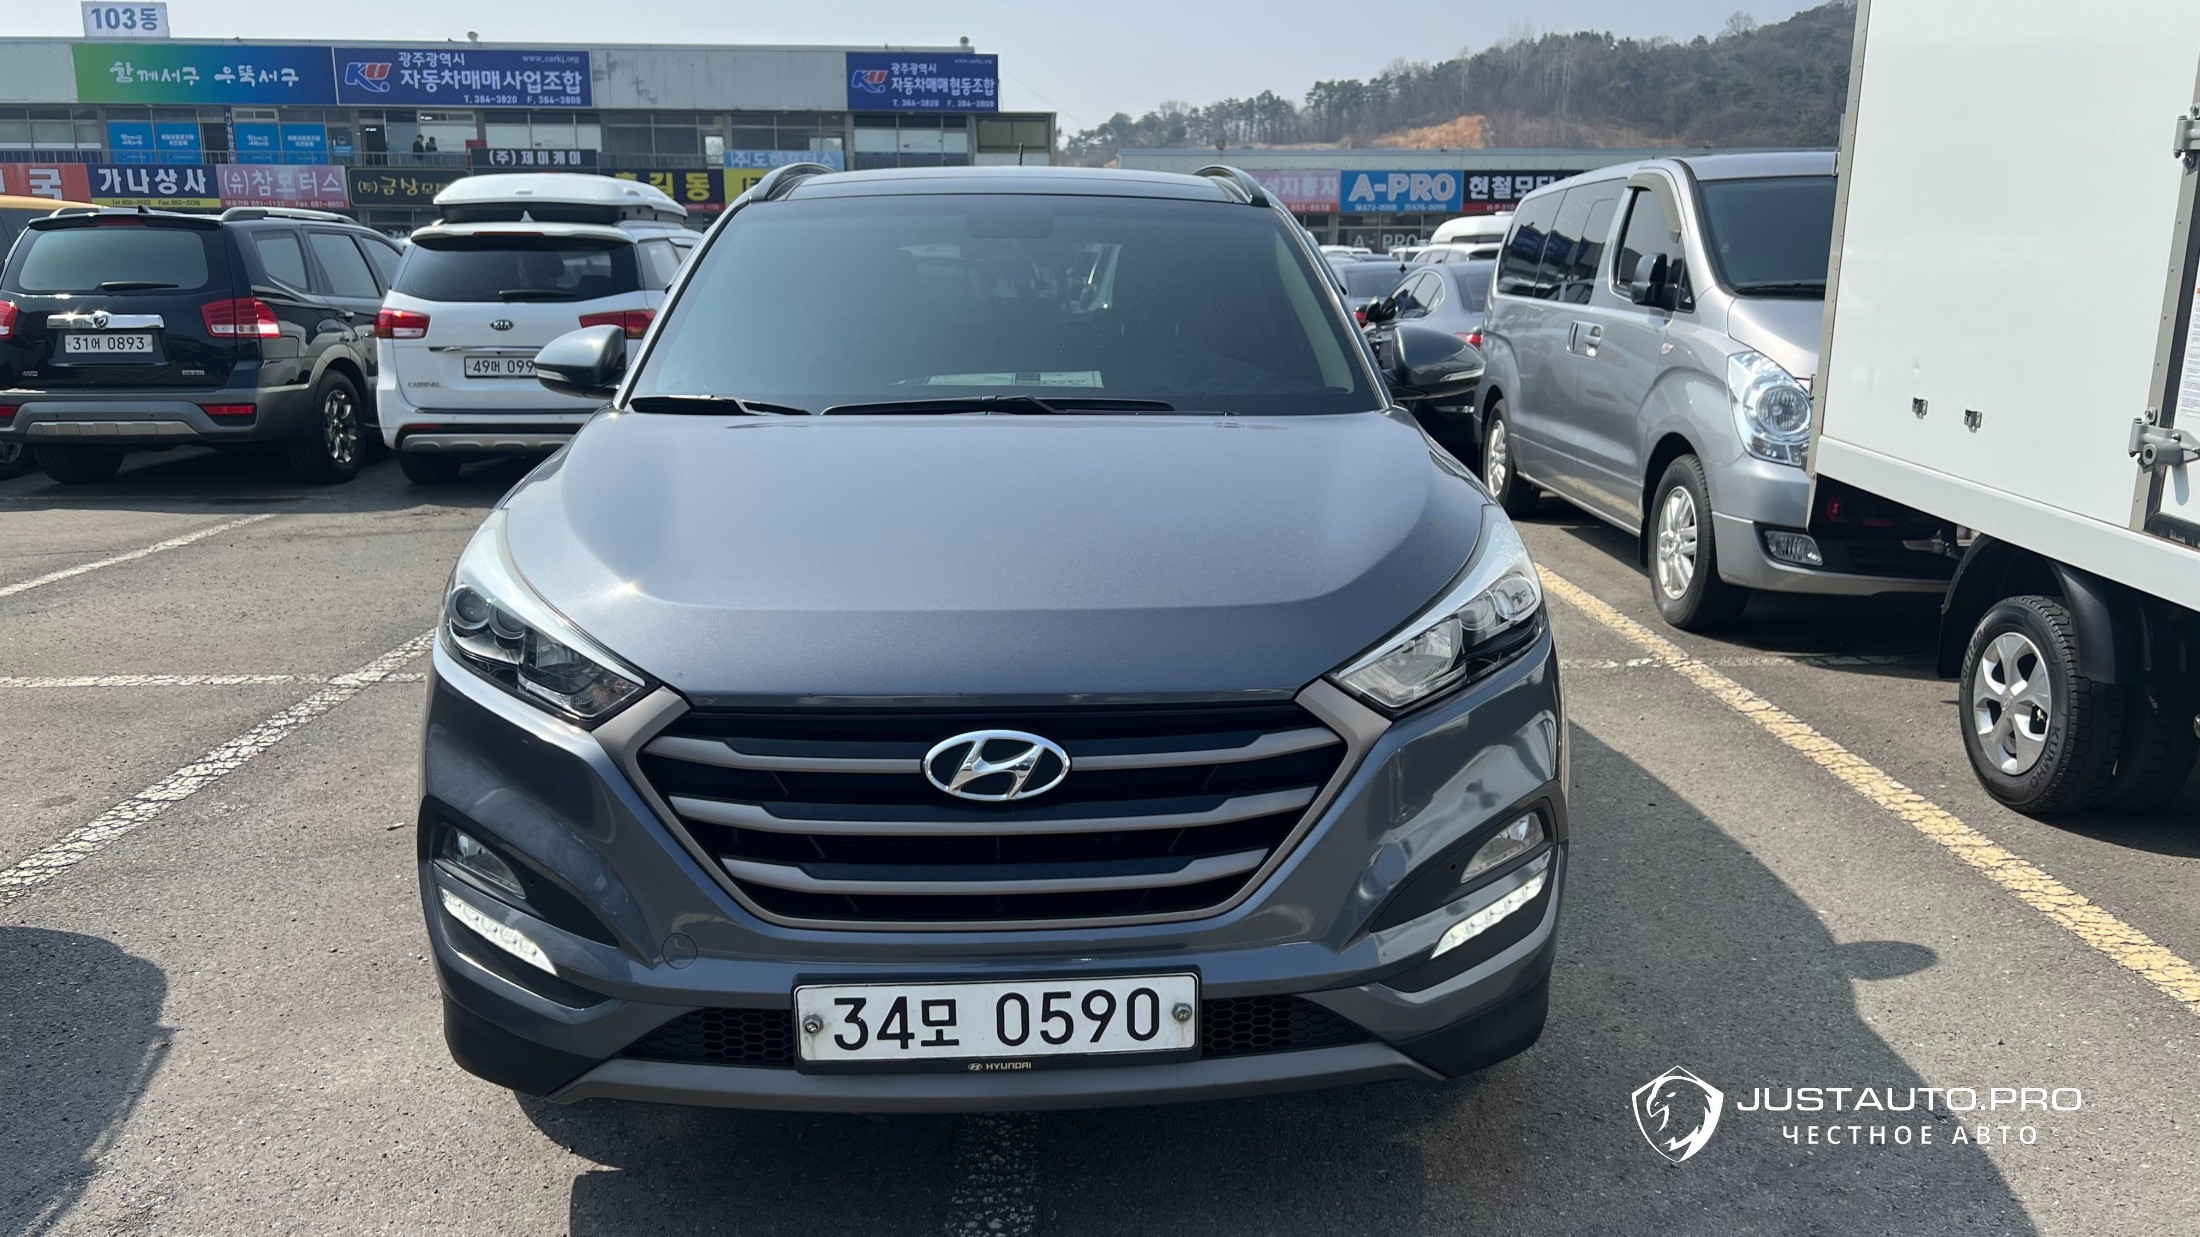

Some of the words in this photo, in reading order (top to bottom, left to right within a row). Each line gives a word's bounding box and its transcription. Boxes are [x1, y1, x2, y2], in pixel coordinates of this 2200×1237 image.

[91, 8, 158, 30] 103동
[399, 52, 465, 68] 광주광역시
[891, 62, 937, 75] 광주광역시
[109, 61, 200, 84] 함께서구
[98, 168, 207, 195] 가나상사
[223, 169, 343, 197] (유)참모터스
[1347, 172, 1456, 202] A-PRO
[493, 320, 511, 330] KIA
[72, 334, 101, 351] 31어
[107, 333, 146, 350] 0893
[833, 995, 960, 1051] 34모
[995, 987, 1161, 1048] 0590
[985, 1061, 1032, 1070] HYUNDAI
